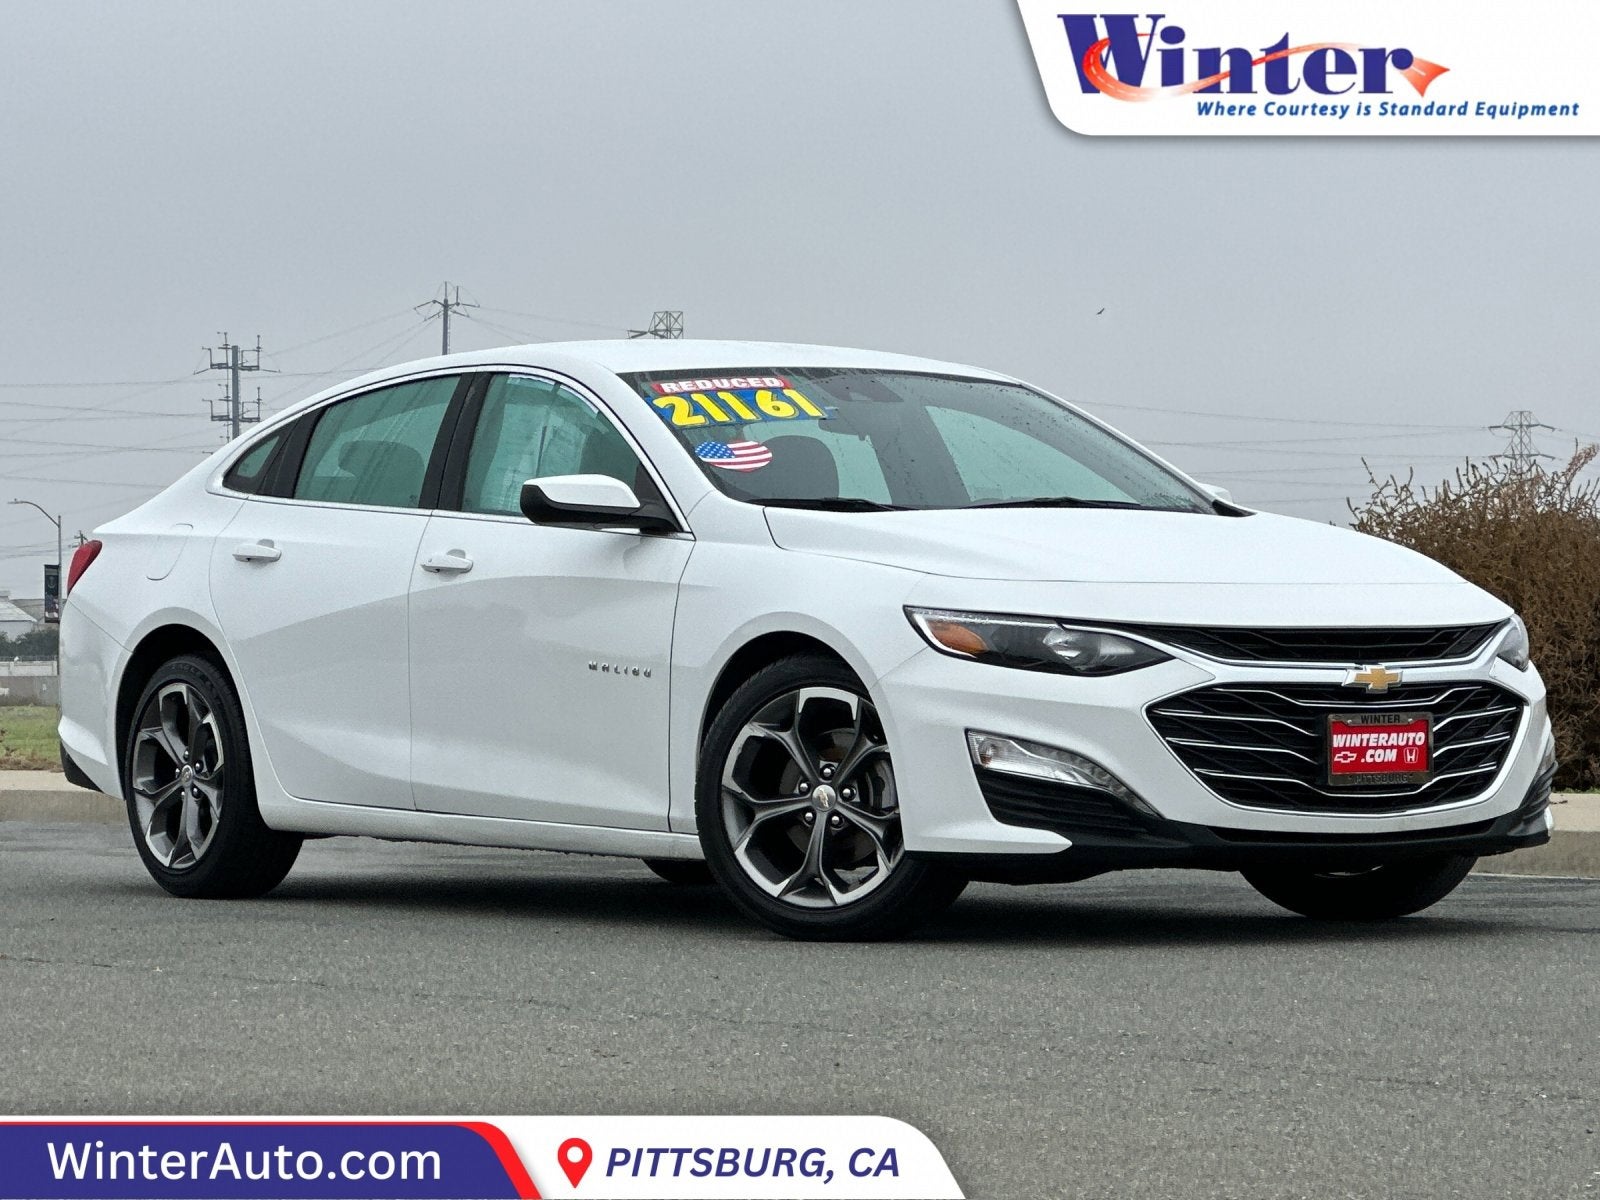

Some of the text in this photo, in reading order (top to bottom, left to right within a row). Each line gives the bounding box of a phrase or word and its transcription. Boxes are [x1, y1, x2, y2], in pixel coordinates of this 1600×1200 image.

[660, 376, 784, 393] REDUCED
[653, 388, 825, 426] 21161
[588, 661, 652, 678] MALIBU
[1361, 714, 1400, 724] WINTER
[1333, 732, 1426, 747] WINTERAUTO
[1361, 749, 1398, 763] .COM
